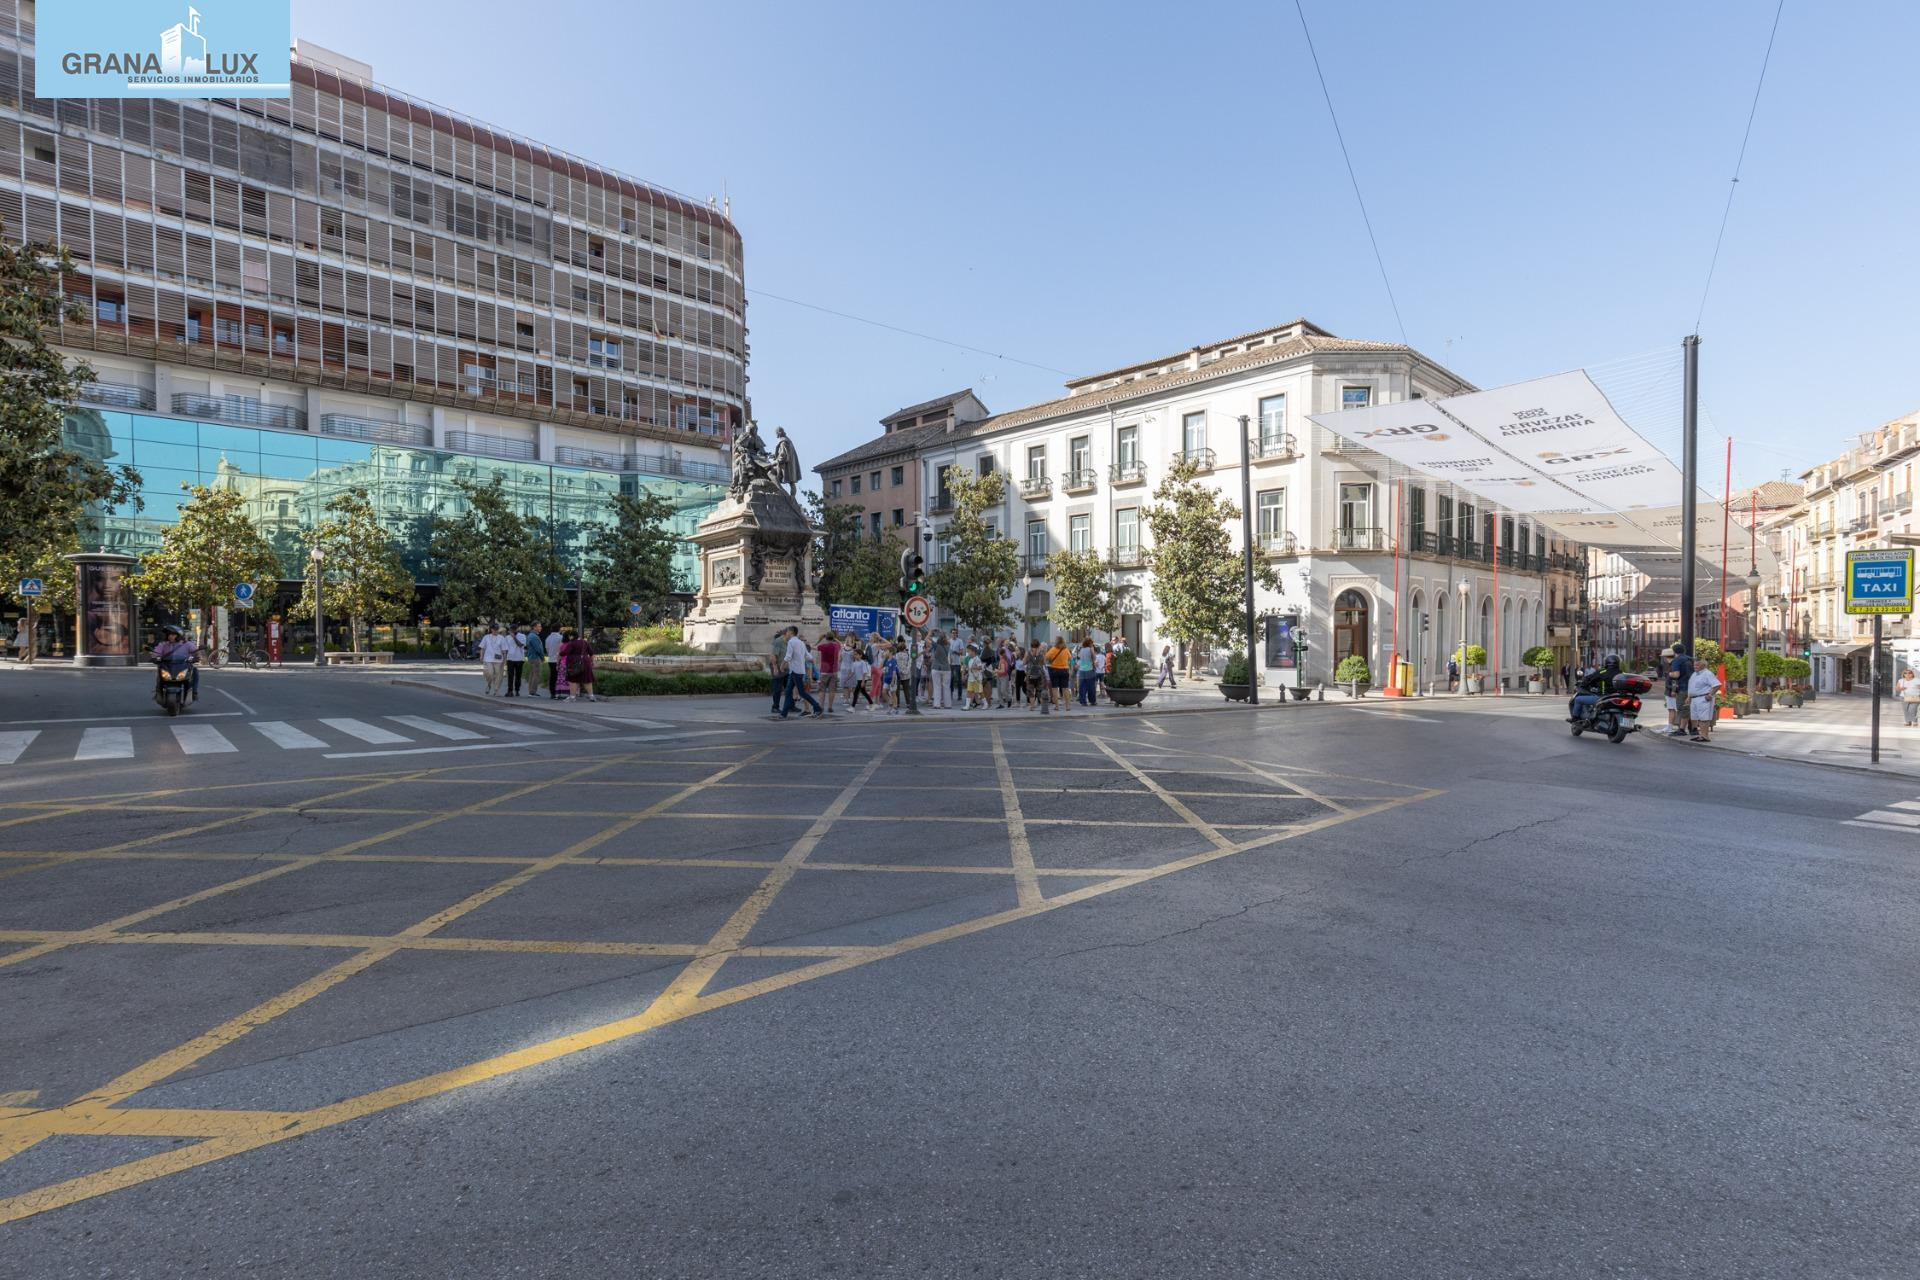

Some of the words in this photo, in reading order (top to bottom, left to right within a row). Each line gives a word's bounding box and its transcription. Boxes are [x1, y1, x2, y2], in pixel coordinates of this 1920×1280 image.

[1499, 413, 1585, 431] CERVEZAS
[1501, 419, 1595, 437] ALHAMBRA
[1545, 447, 1632, 465] GRX
[1576, 465, 1647, 479] CERVEZAS
[1577, 467, 1655, 483] ALHAMBRA
[1861, 583, 1897, 593] TAXI
[832, 608, 870, 620] atlanta
